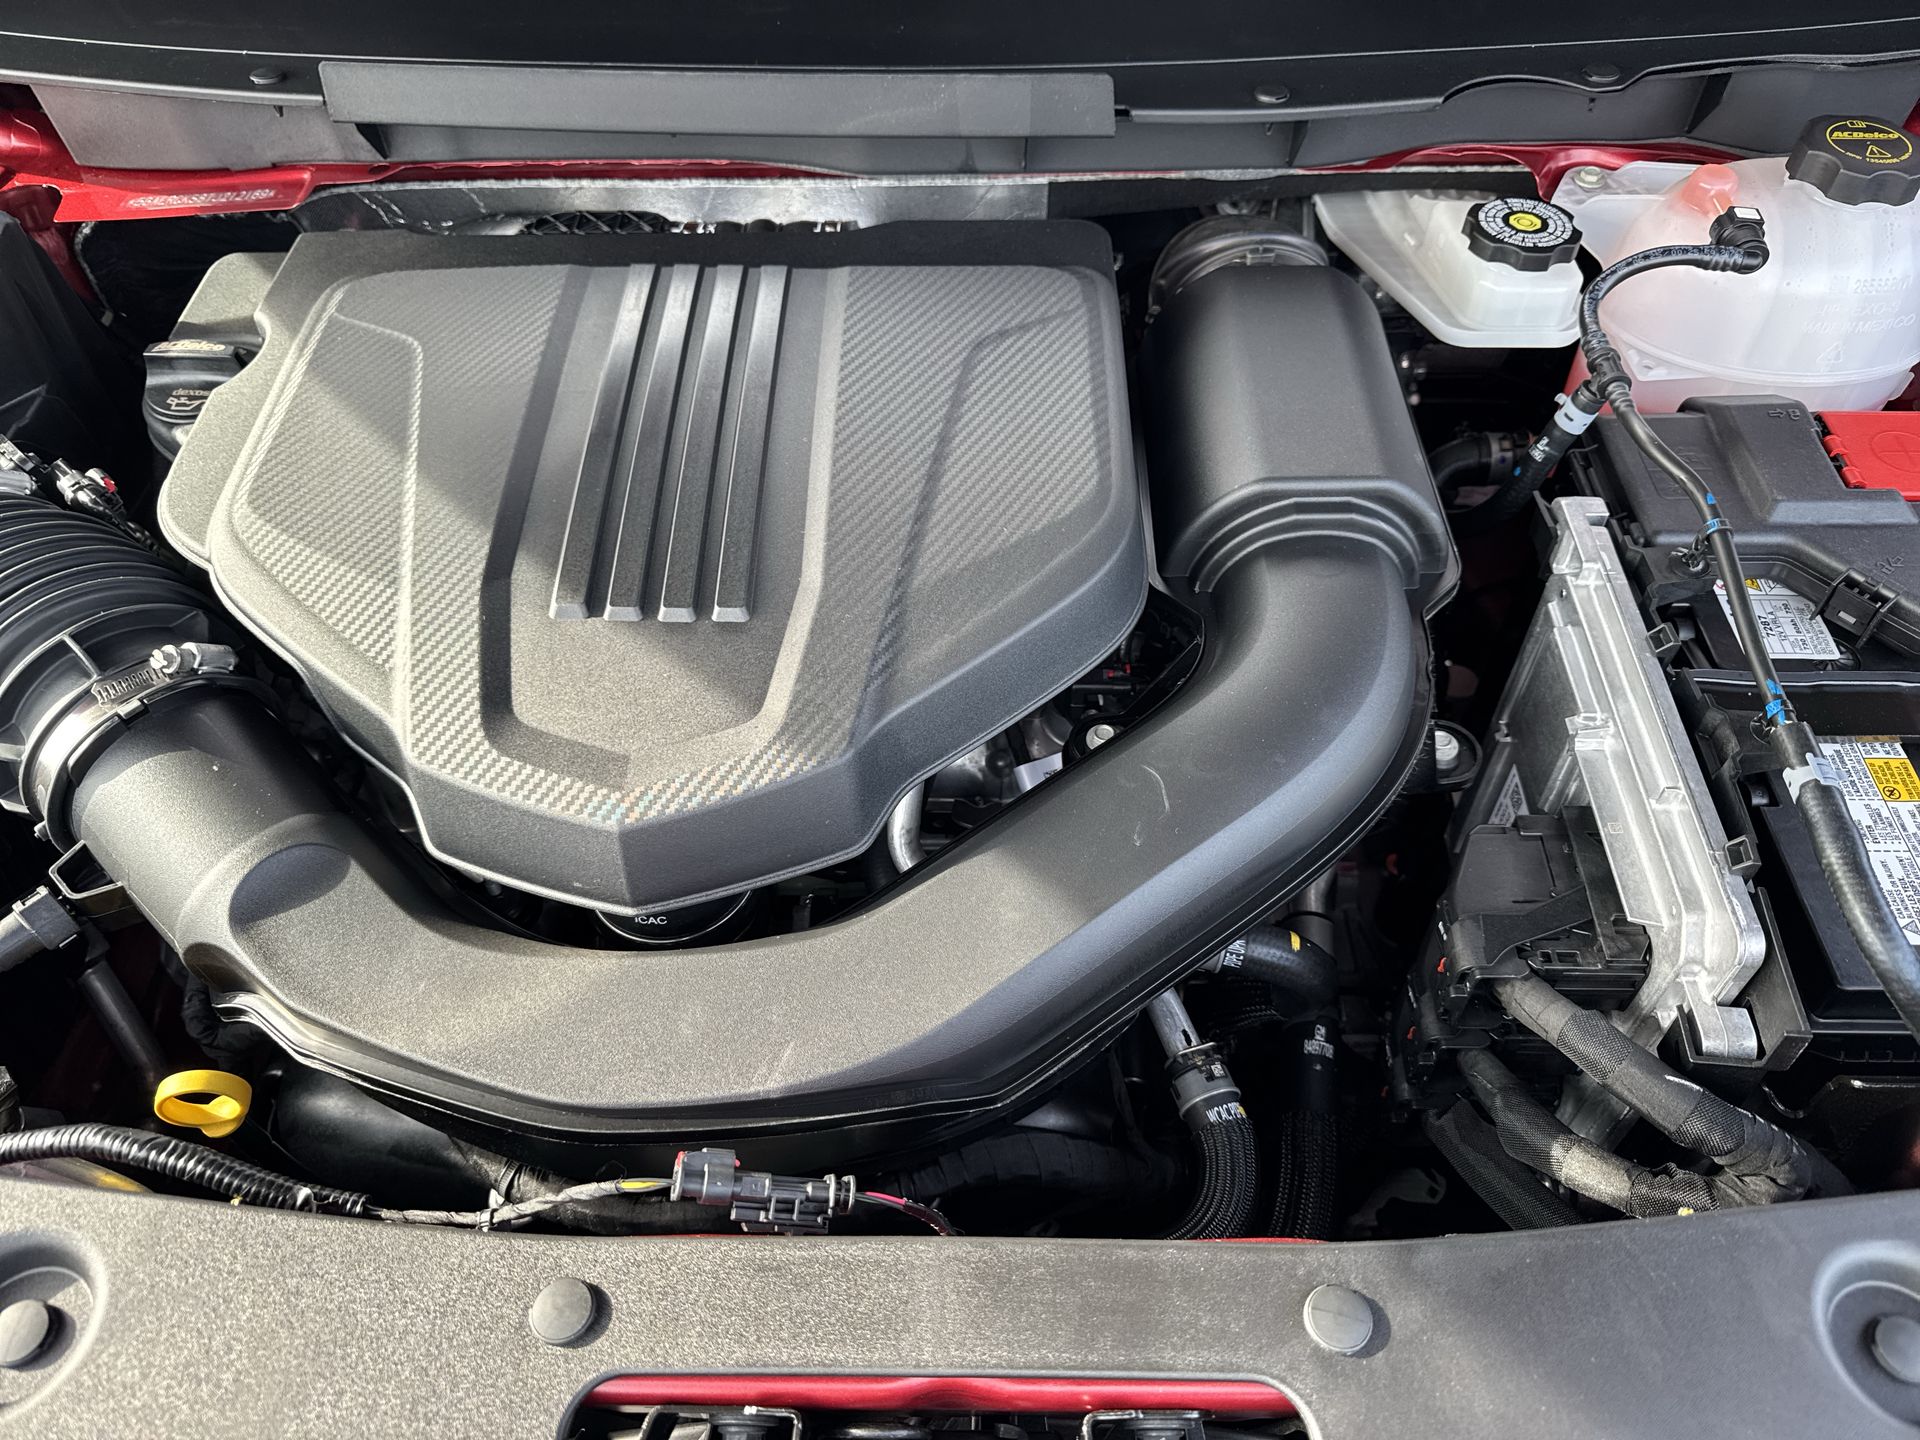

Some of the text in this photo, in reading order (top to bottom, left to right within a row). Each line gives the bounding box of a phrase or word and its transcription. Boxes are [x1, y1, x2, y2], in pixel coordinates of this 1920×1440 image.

[1831, 131, 1899, 139] ACDelco
[1856, 313, 1916, 334] MEXICO
[1757, 615, 1775, 637] 7287
[1895, 855, 1913, 878] PEUVENT
[1885, 889, 1899, 906] CAUSE
[1893, 889, 1914, 918] BLINDNESS
